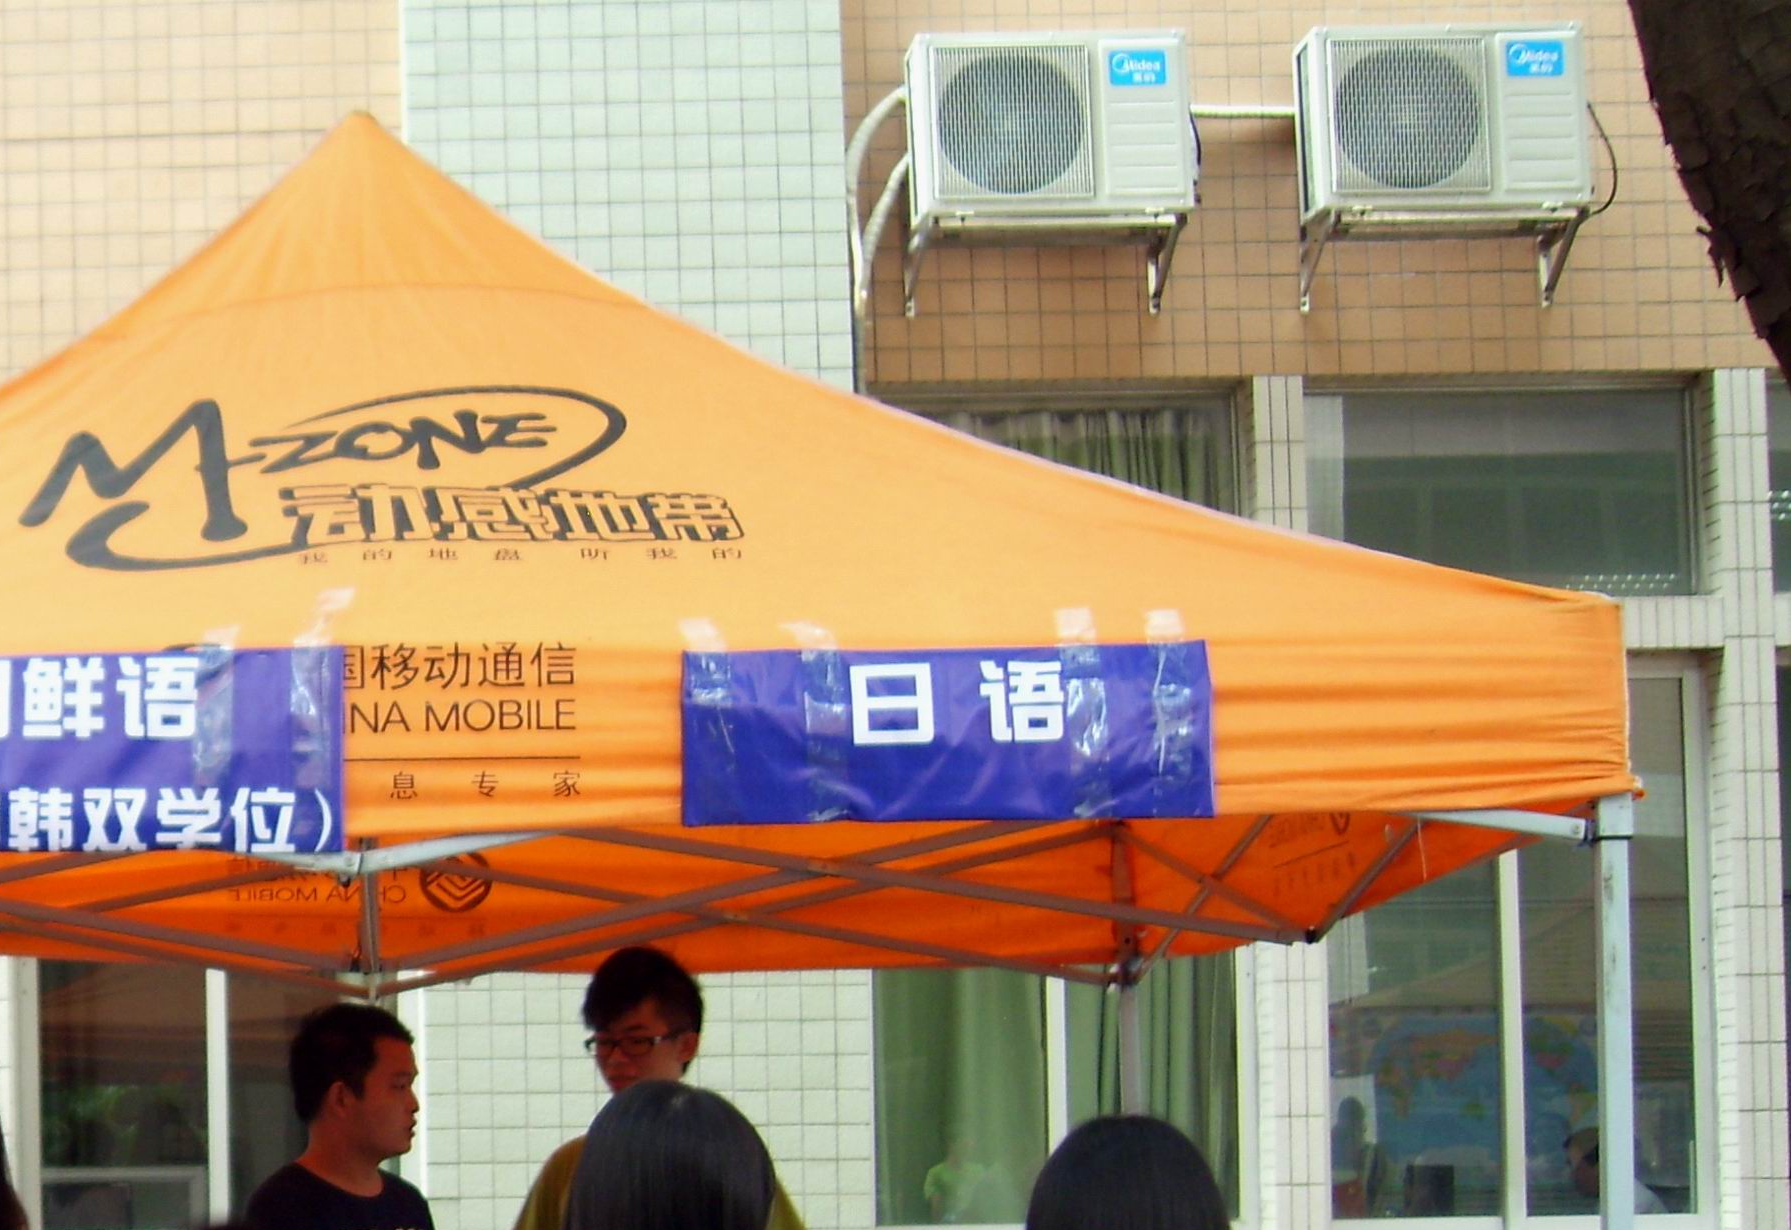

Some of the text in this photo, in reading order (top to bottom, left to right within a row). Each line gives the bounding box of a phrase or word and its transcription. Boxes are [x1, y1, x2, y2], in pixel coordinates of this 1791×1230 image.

[277, 484, 746, 544] 动感地带
[425, 699, 577, 732] MOBILE
[849, 661, 1064, 746] 日语
